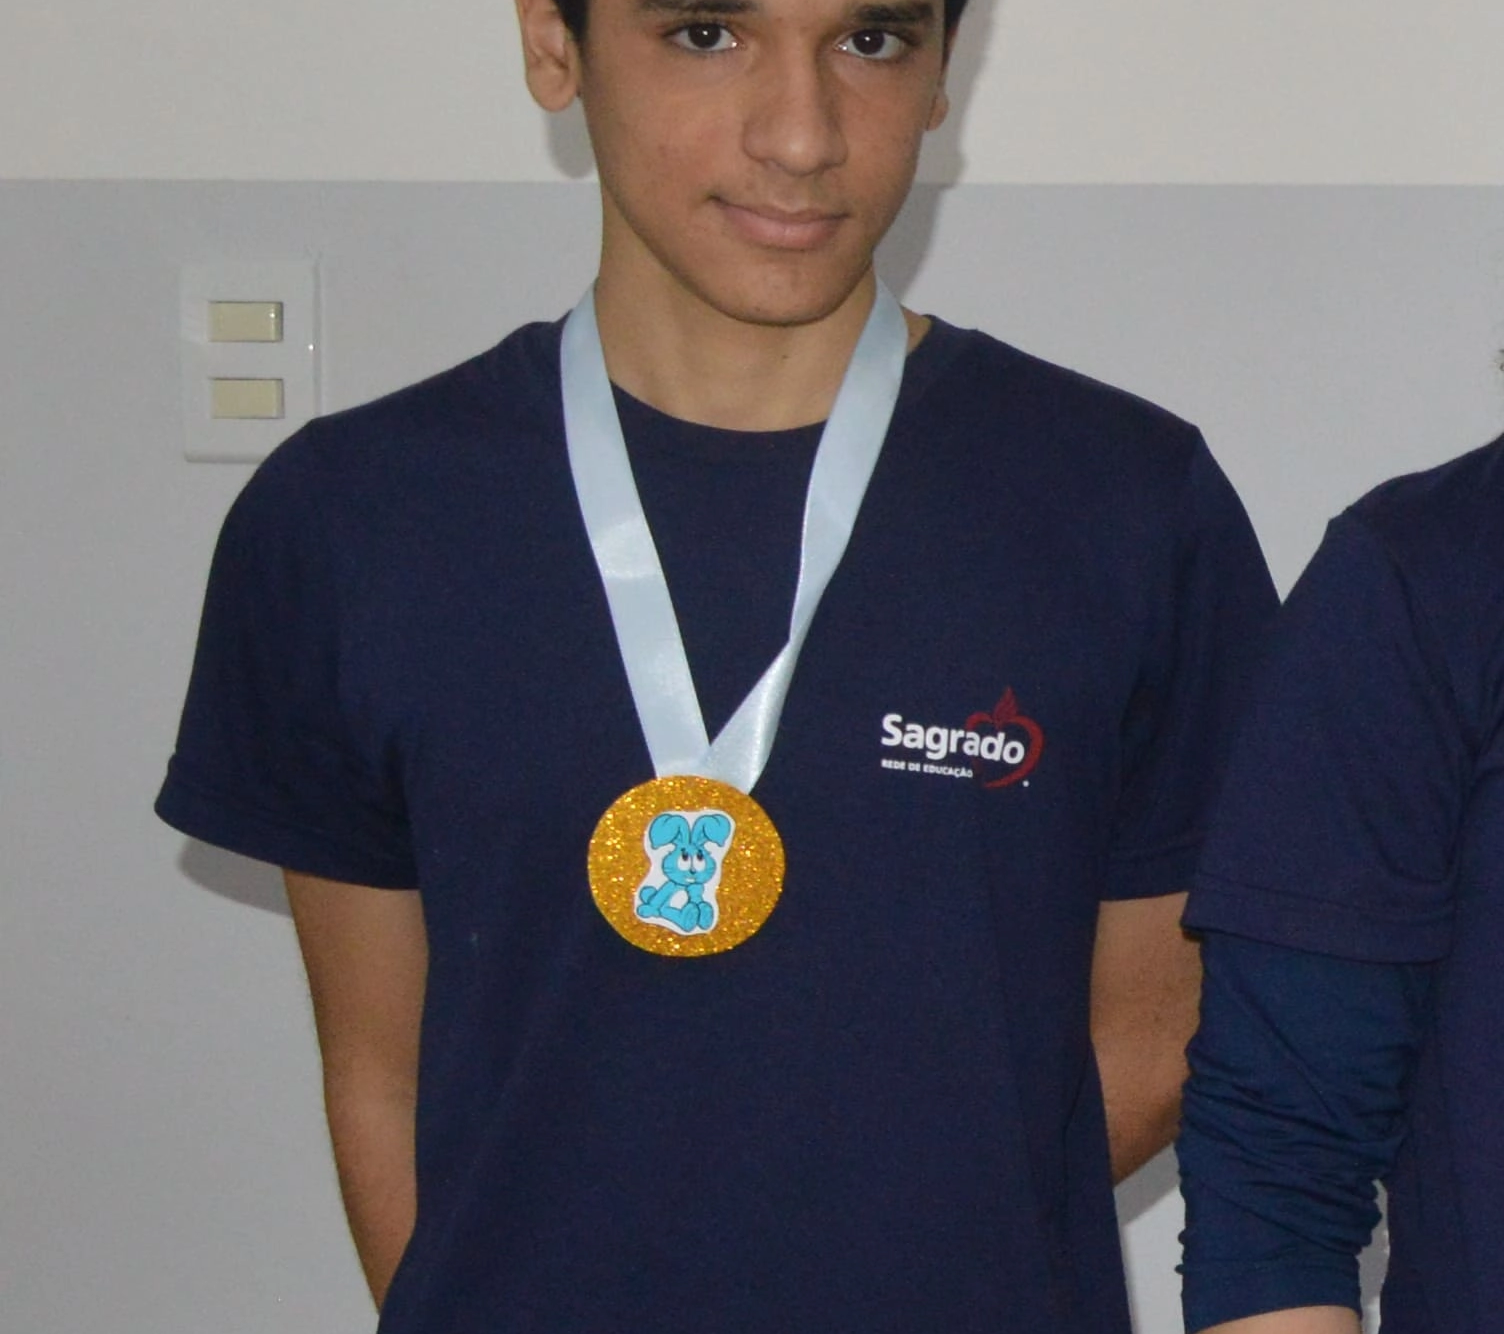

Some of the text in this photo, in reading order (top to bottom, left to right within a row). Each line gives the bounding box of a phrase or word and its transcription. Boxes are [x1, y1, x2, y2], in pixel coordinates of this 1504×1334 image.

[881, 713, 1025, 764] Sagrado
[881, 759, 974, 778] REDE DE EDUCAÇÃO
